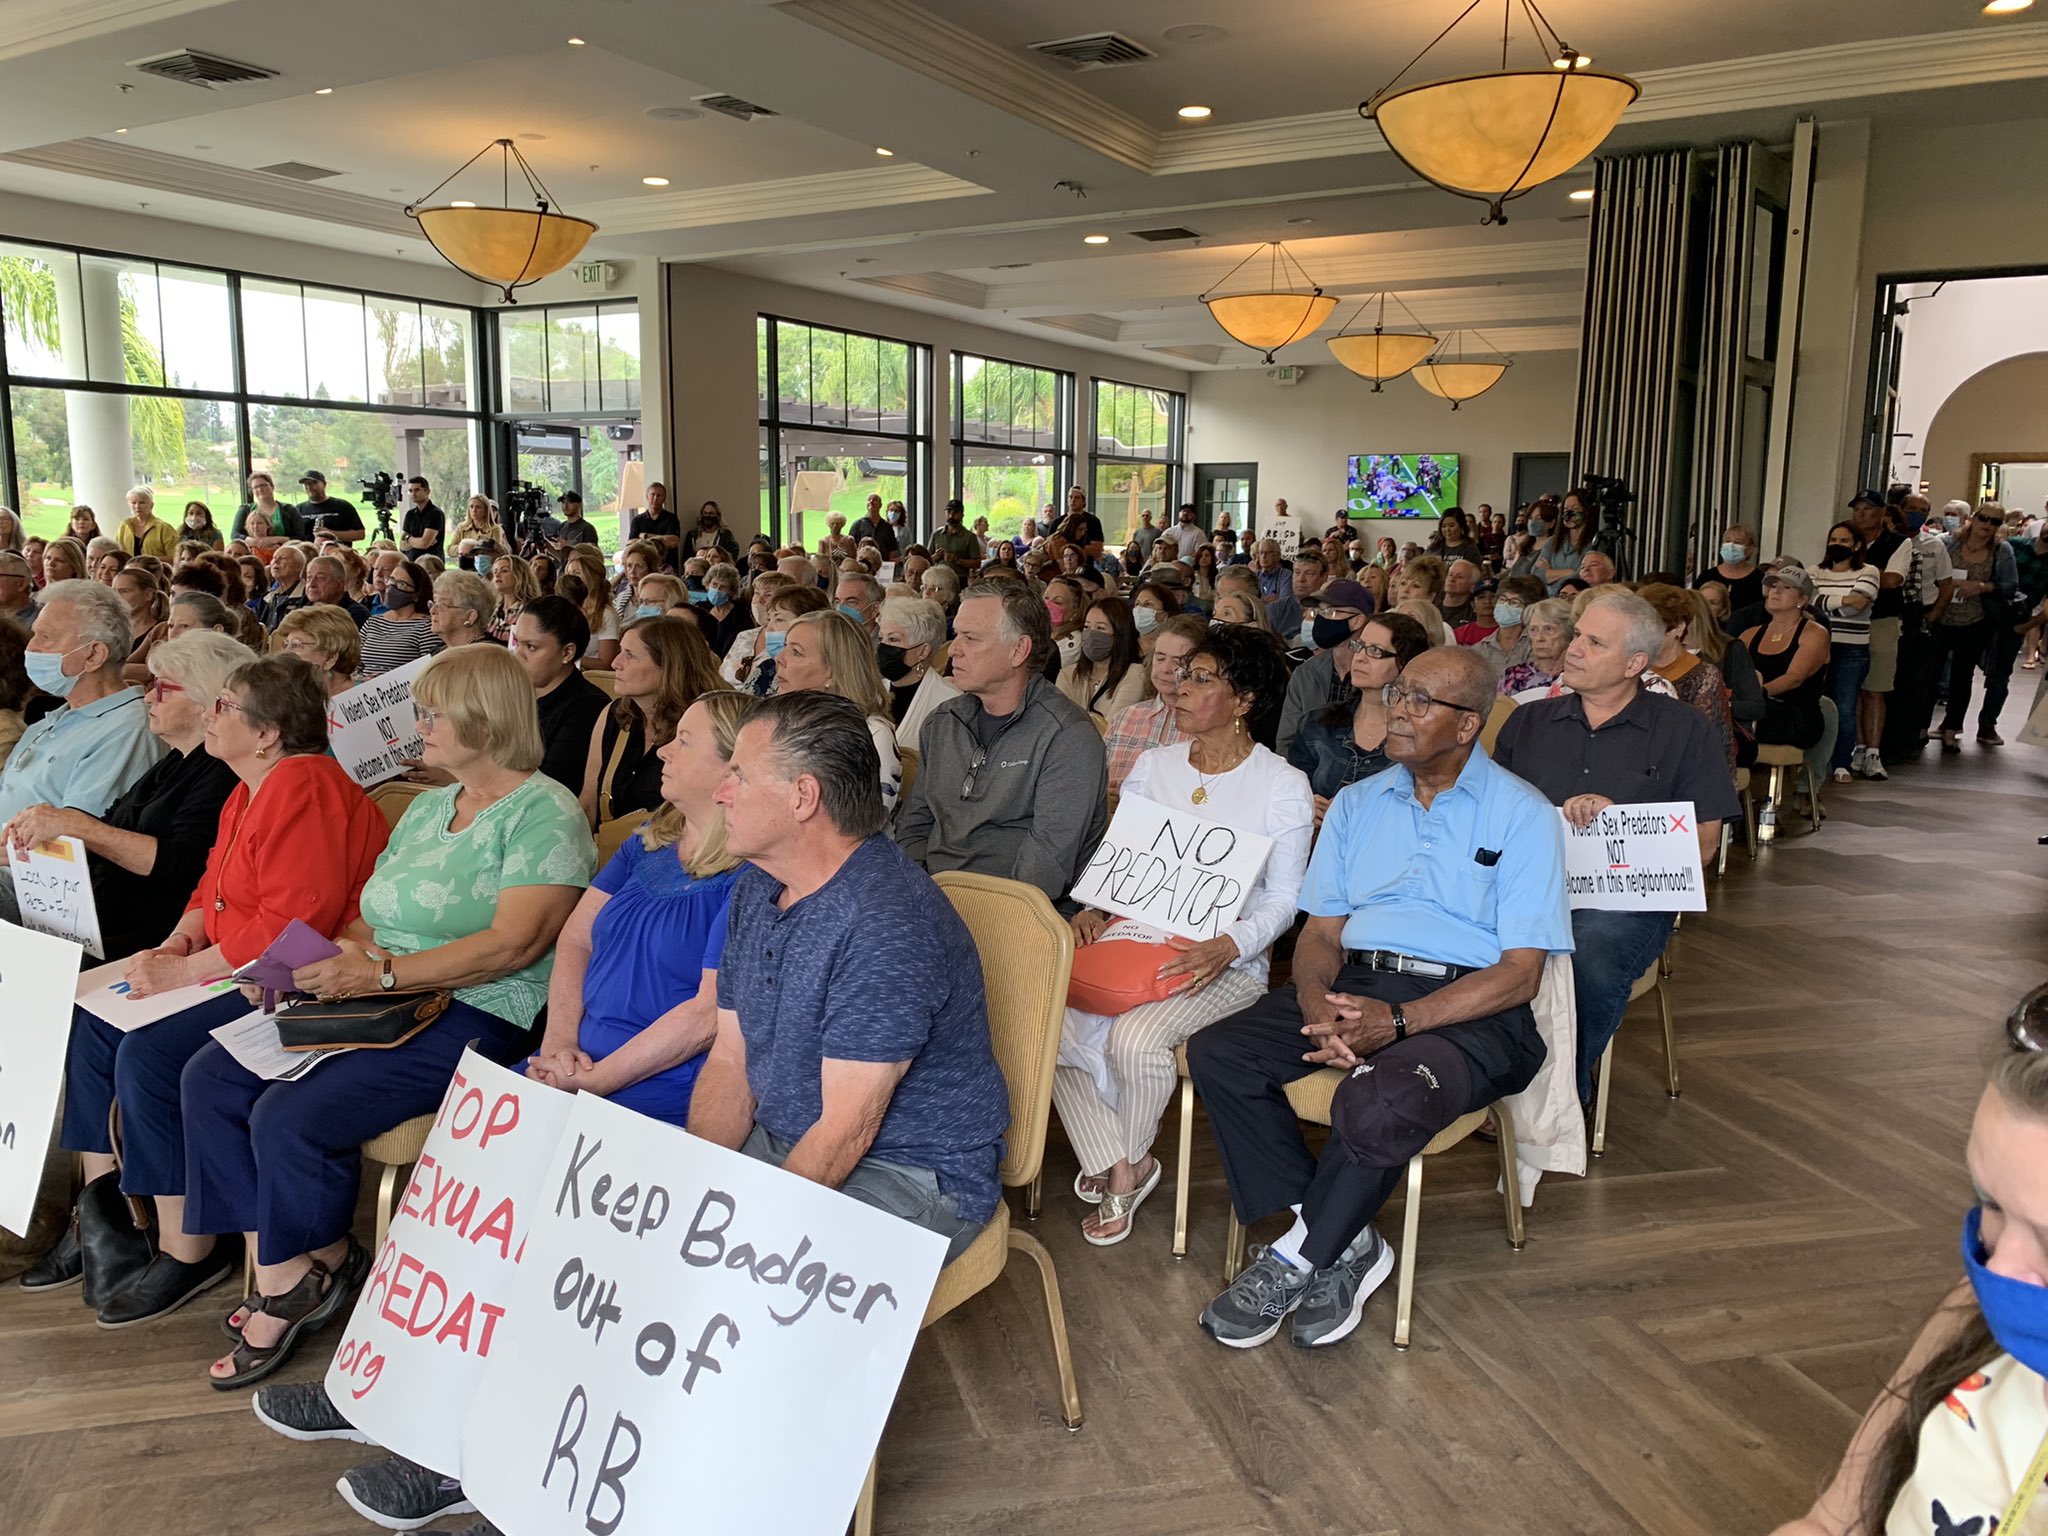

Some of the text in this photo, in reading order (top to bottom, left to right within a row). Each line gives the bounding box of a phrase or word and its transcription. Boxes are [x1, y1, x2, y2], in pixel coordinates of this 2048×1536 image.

[583, 265, 601, 283] EXIT
[338, 697, 369, 724] Violent
[363, 693, 382, 714] Sex
[376, 716, 397, 742] NOT
[353, 757, 386, 781] welcome
[380, 751, 394, 769] in
[1602, 811, 1620, 836] Sex
[1620, 810, 1667, 835] Predators
[1151, 818, 1236, 866] NO
[1606, 839, 1626, 864] NOT
[1073, 840, 1241, 938] PREDATOR
[1595, 869, 1605, 893] in
[1606, 868, 1624, 893] this
[396, 1153, 529, 1264] EXUA
[555, 1132, 898, 1327] Keep Badger
[635, 1312, 740, 1395] of
[542, 1384, 642, 1536] RB
